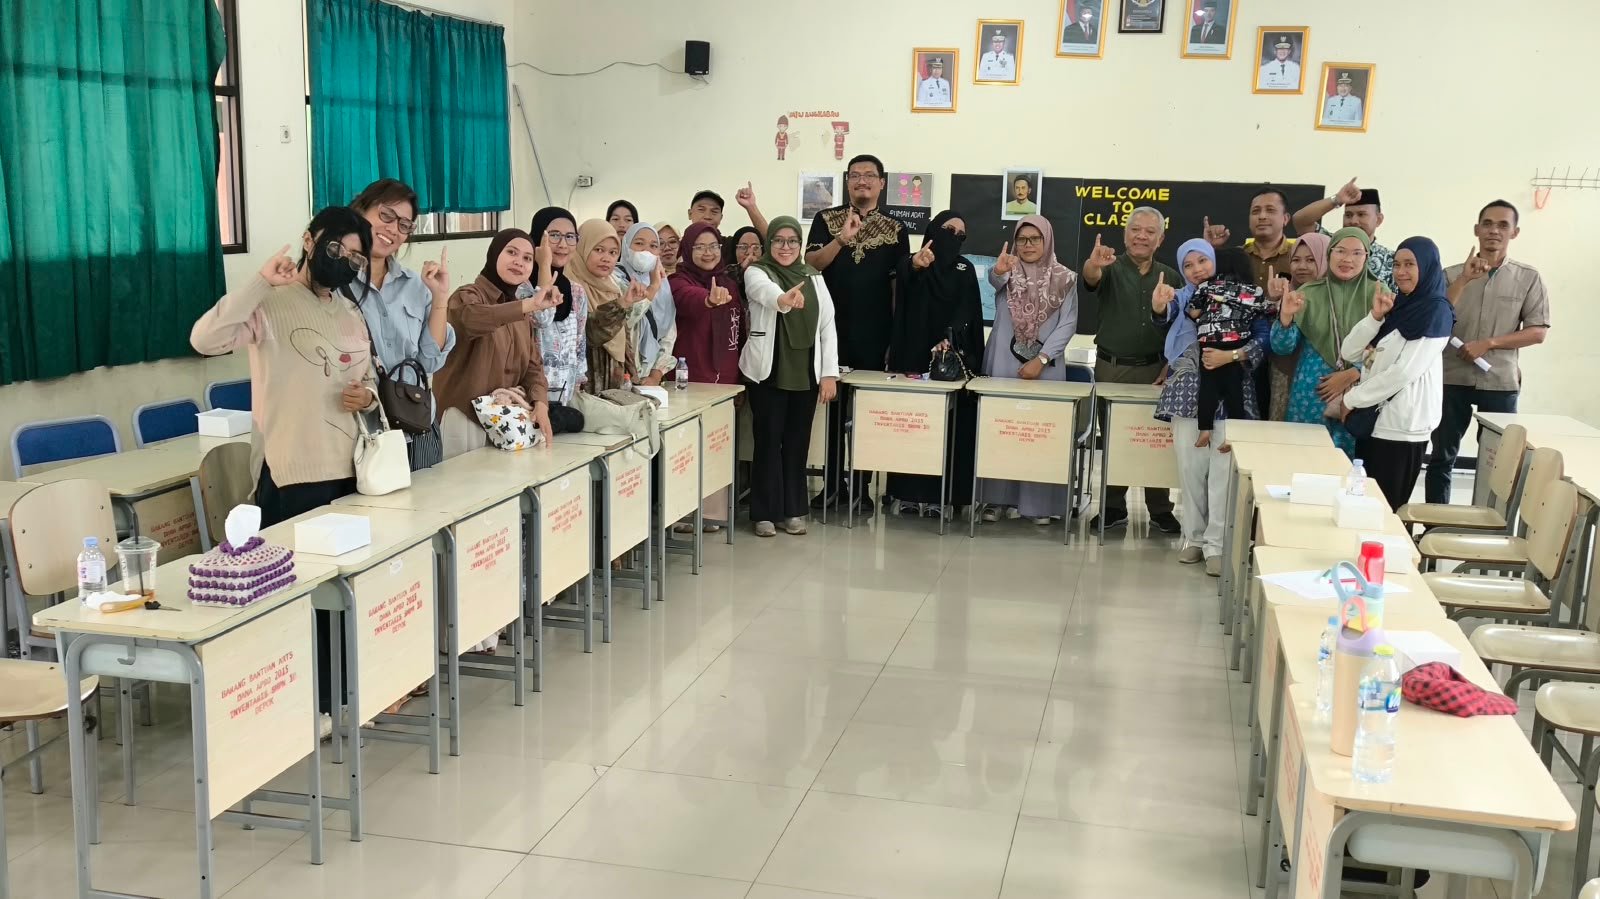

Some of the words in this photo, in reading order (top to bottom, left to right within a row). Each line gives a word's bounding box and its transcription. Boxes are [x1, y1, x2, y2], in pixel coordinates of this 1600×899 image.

[1075, 186, 1170, 201] WELCOME
[1113, 201, 1134, 213] TO
[275, 665, 288, 680] 2015
[230, 690, 268, 719] INVENTARIS
